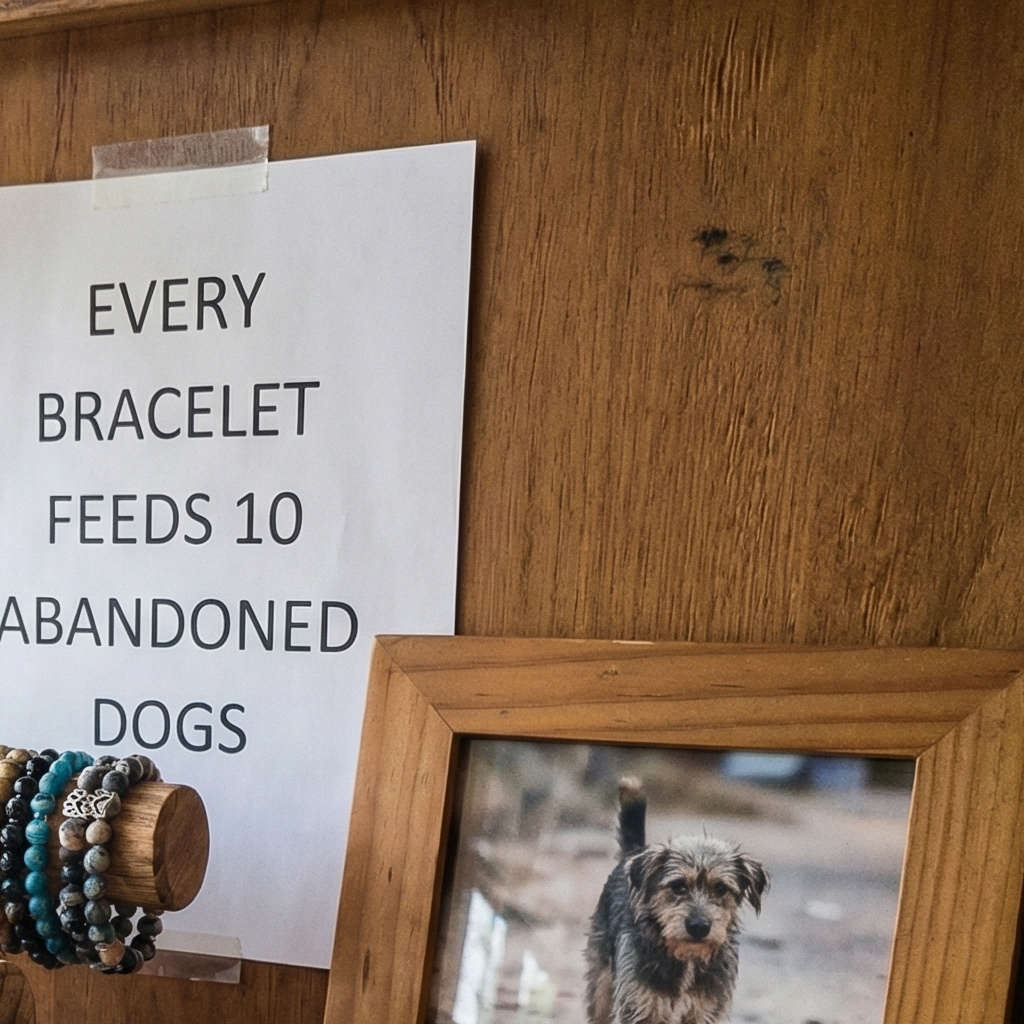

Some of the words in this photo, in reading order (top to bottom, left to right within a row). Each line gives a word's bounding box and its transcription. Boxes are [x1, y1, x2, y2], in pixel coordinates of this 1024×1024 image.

[89, 272, 267, 337] EVERY
[38, 380, 321, 443] BRACELET
[48, 492, 213, 546] FEEDS
[235, 491, 304, 546] 10
[93, 697, 248, 755] DOGS
